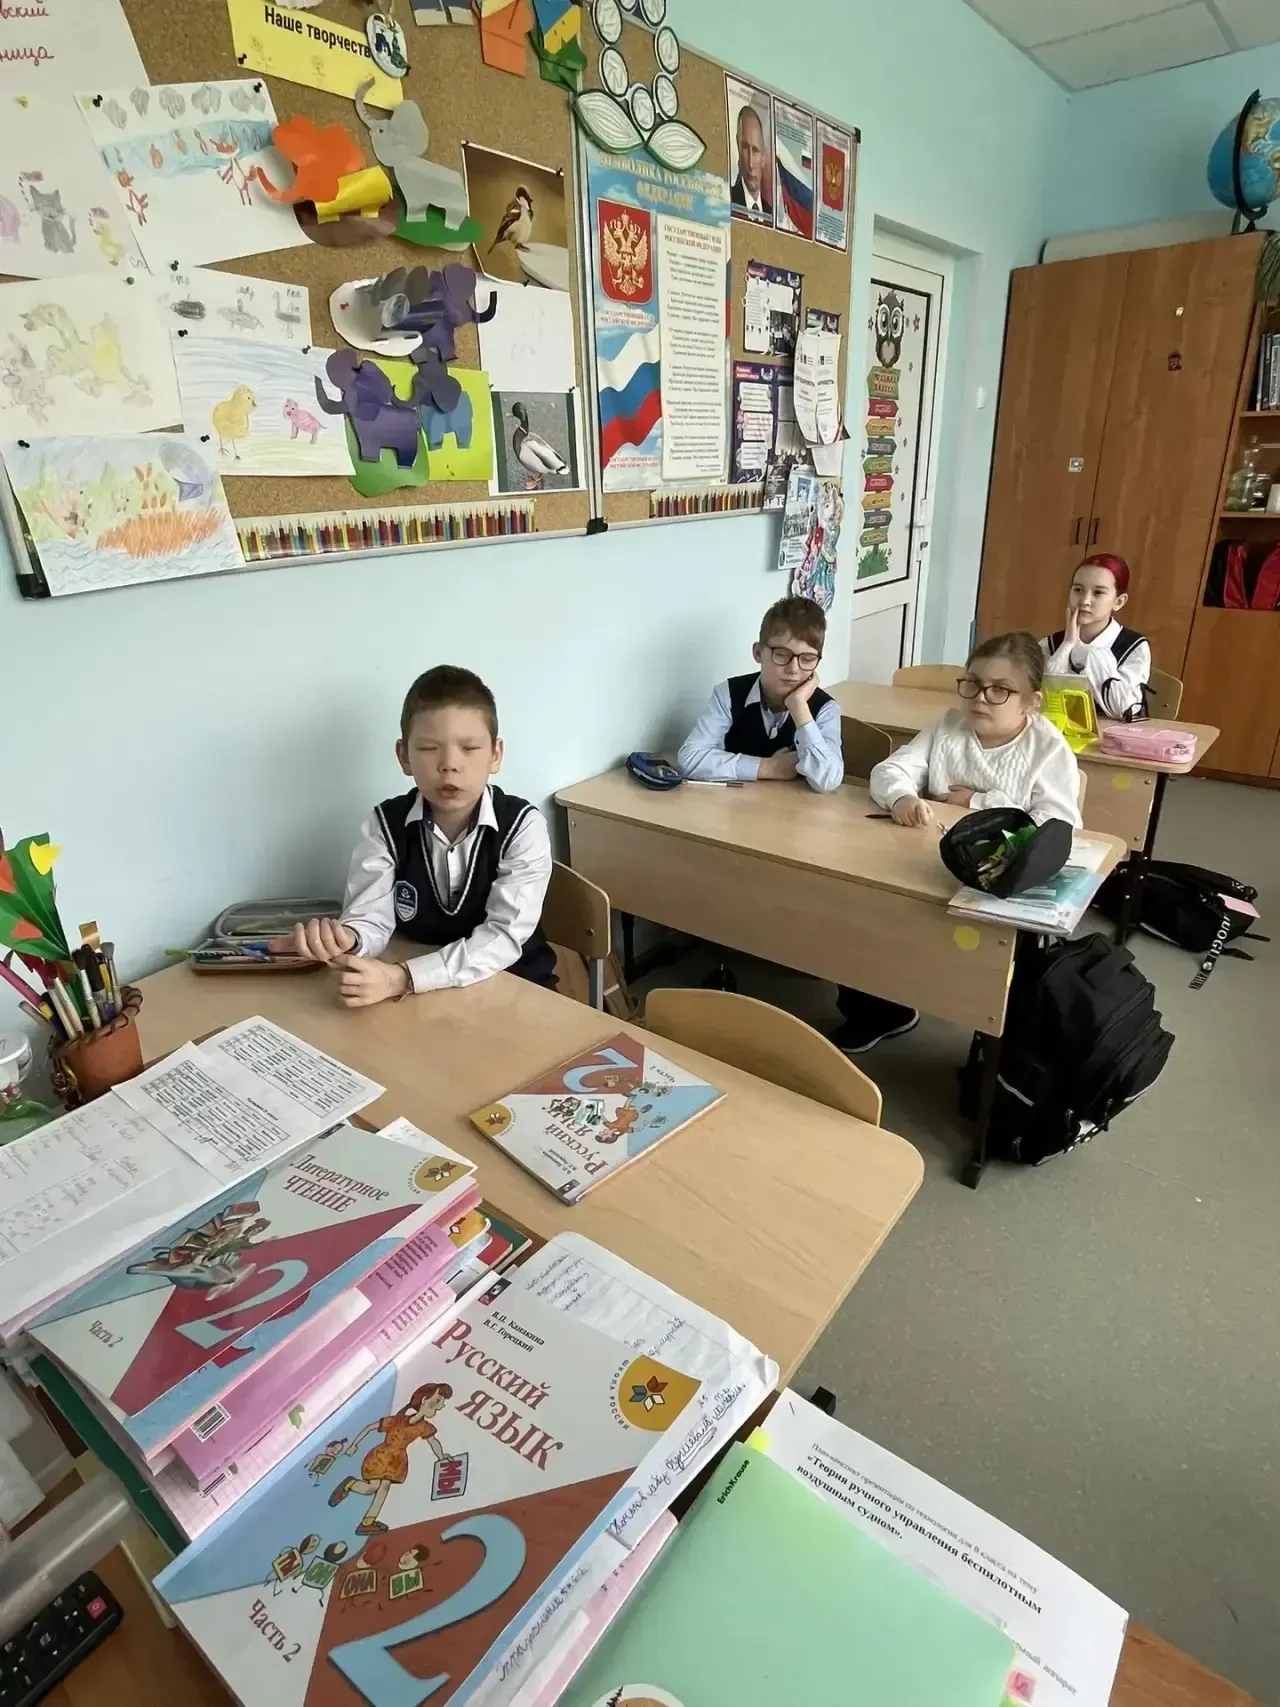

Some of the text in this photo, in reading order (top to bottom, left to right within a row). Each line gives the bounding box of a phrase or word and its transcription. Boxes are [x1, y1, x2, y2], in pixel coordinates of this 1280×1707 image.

[264, 5, 303, 34] Наше
[562, 1048, 638, 1093] 2
[544, 1122, 610, 1175] Русский
[282, 1175, 356, 1213] ЧТЕНИЕ
[287, 1153, 389, 1201] Литературное
[174, 1260, 309, 1349] 2
[88, 1320, 112, 1343] Часть
[497, 1325, 534, 1353] Горецкий
[508, 1318, 545, 1347] Канакина
[432, 1318, 553, 1411] Русский
[455, 1389, 564, 1471] ЯЗЫК
[609, 1402, 631, 1430] РОССИИ
[436, 1460, 462, 1496] МЫ
[717, 1459, 750, 1505] ErichKrause
[797, 1465, 904, 1540] воздушным судном».
[807, 1454, 1042, 1615] «Теория ручного управления беспилотным
[305, 1562, 335, 1586] ОН
[343, 1570, 375, 1594] ОНА
[391, 1572, 420, 1596] ВЫ
[248, 1599, 302, 1663] Часть 2
[328, 1514, 526, 1707] 2
